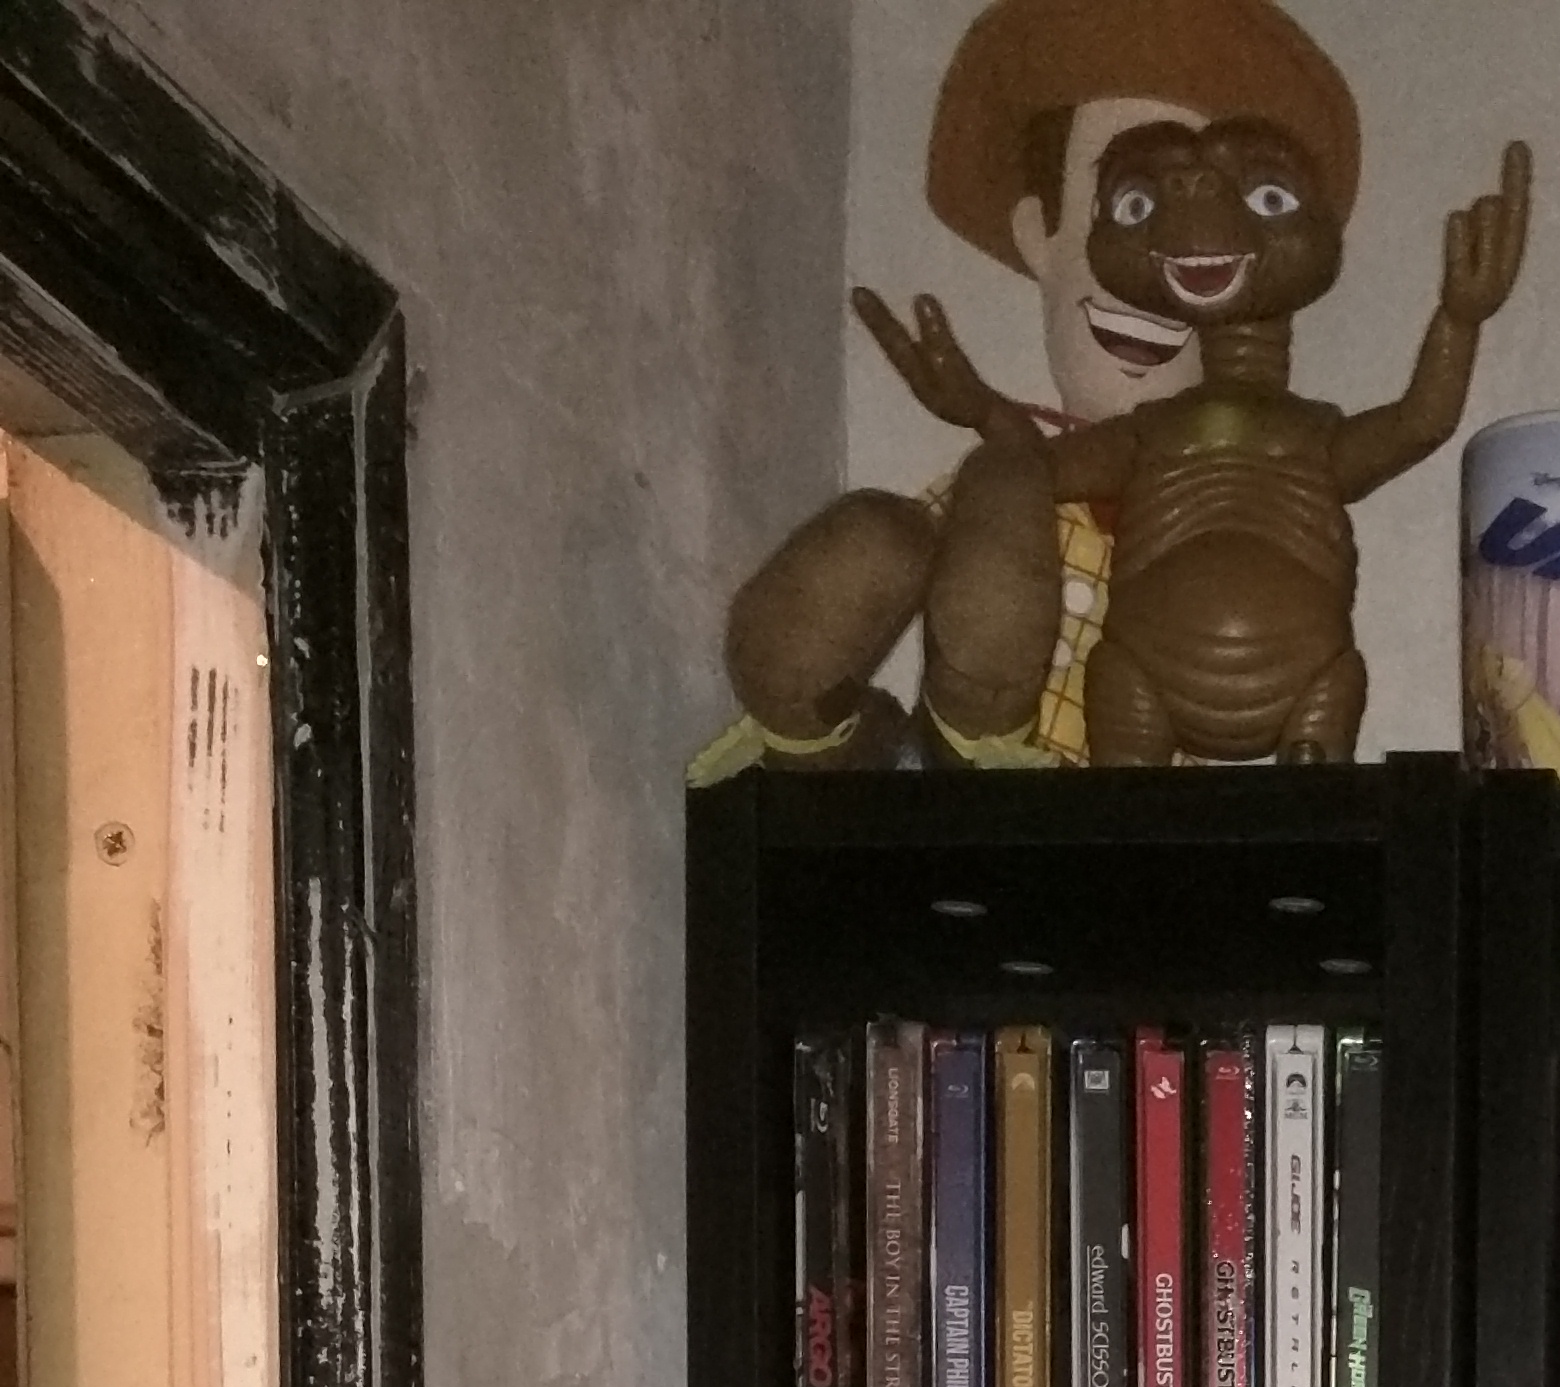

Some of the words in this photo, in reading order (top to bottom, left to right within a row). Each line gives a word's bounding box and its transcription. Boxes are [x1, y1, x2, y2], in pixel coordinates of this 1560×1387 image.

[888, 1067, 899, 1144] LIONSGATE
[885, 1229, 900, 1268] BOY
[885, 1276, 900, 1297] IN
[1091, 1245, 1110, 1314] edward
[885, 1307, 900, 1346] THE
[944, 1285, 970, 1352] CAPTAIN
